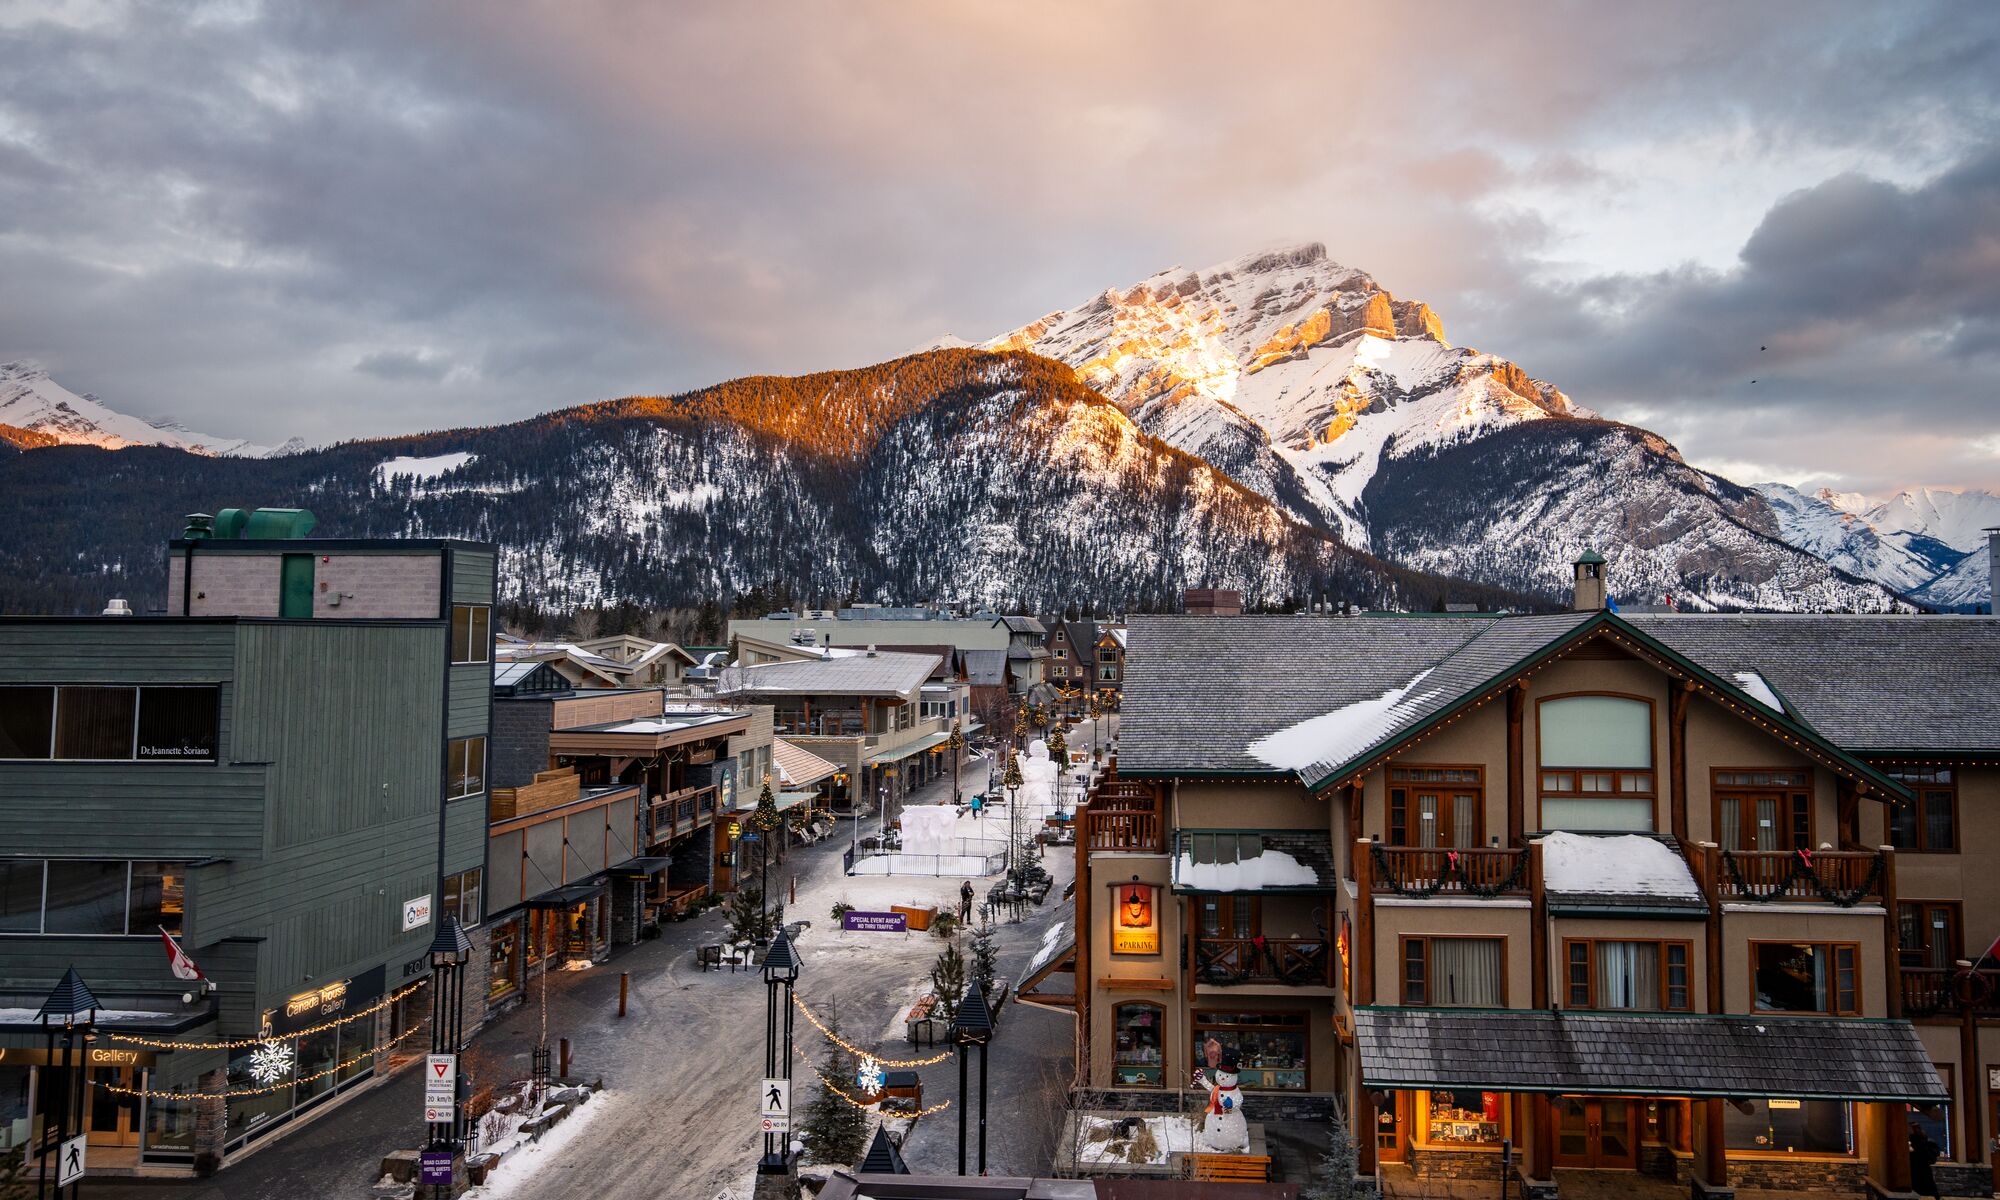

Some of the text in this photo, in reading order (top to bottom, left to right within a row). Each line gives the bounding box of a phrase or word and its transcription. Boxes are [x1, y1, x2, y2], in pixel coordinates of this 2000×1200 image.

[151, 746, 182, 756] Jeannette
[183, 746, 210, 755] Soriano
[416, 906, 429, 917] bite
[1123, 941, 1153, 949] PARKING
[286, 985, 347, 1017] Canada House
[320, 999, 347, 1016] Gallery
[91, 1049, 138, 1065] Gallery
[437, 1095, 452, 1103] km/h
[718, 1192, 727, 1200] NO
